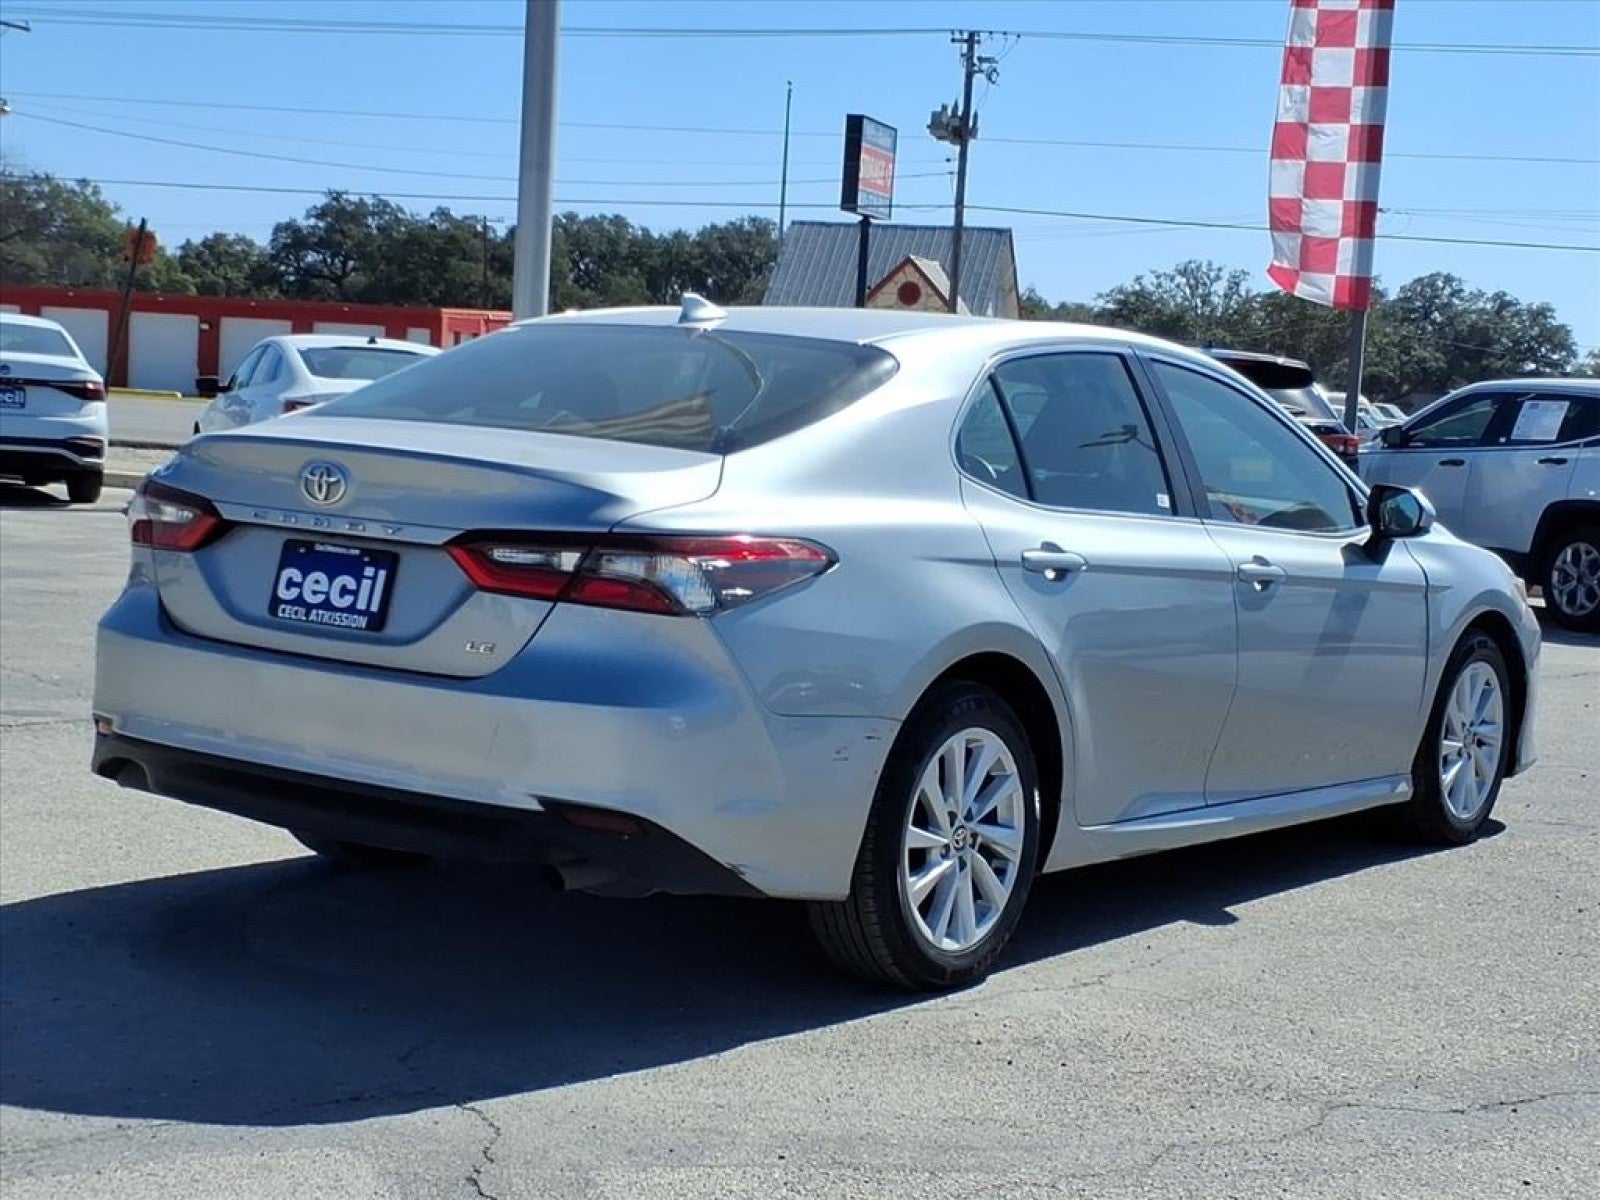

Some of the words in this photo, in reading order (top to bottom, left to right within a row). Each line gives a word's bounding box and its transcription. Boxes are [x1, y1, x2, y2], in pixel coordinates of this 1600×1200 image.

[277, 566, 387, 612] cecil
[278, 603, 307, 620] CECIL
[308, 608, 368, 629] ATKISSION
[464, 641, 495, 654] LE
